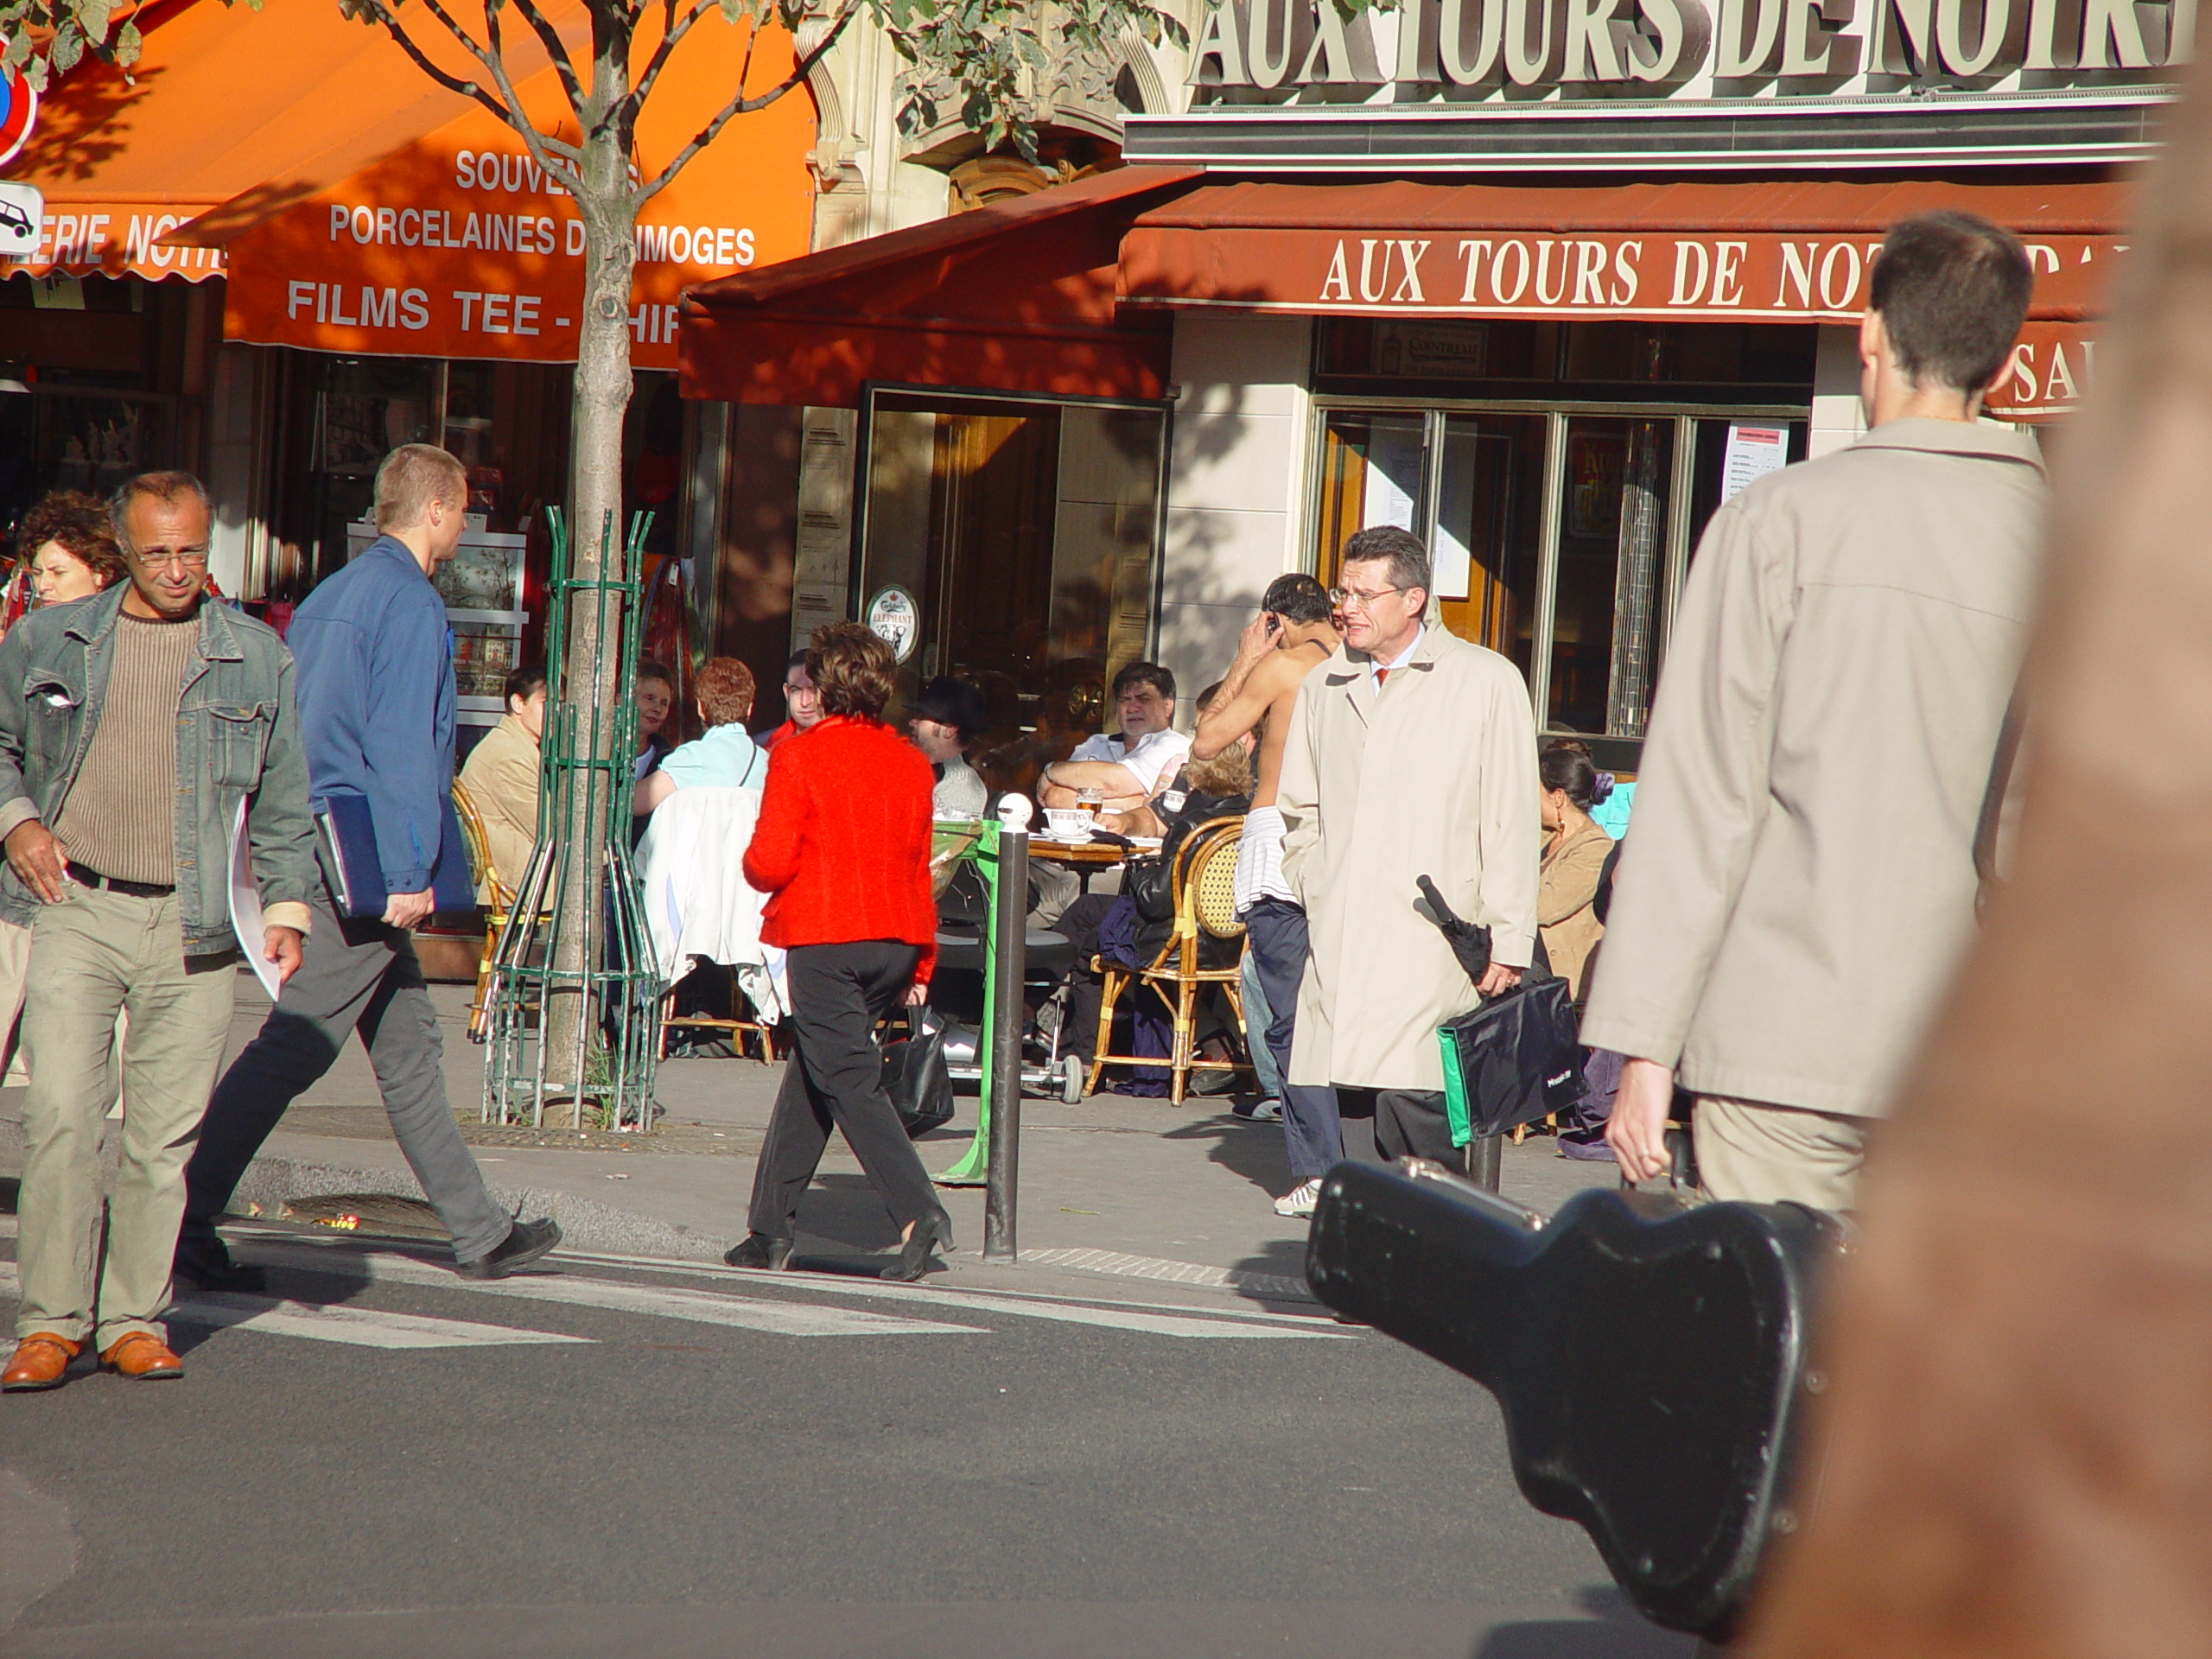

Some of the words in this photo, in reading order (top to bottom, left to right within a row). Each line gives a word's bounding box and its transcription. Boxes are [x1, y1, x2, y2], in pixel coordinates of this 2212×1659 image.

[1185, 0, 1357, 88] AUX
[1711, 0, 1832, 79] DE
[1865, 0, 2195, 77] NOTR
[329, 204, 556, 255] PORCELAINES
[565, 219, 587, 257] D
[635, 225, 756, 266] IMOGES
[1319, 238, 1432, 302] AUX
[1458, 238, 1643, 307] TOURS
[1667, 240, 1749, 307] DE
[1772, 242, 1885, 309] NO
[287, 279, 430, 331] FILMS
[452, 289, 542, 336] TEE
[874, 613, 912, 624] ELEPHANT
